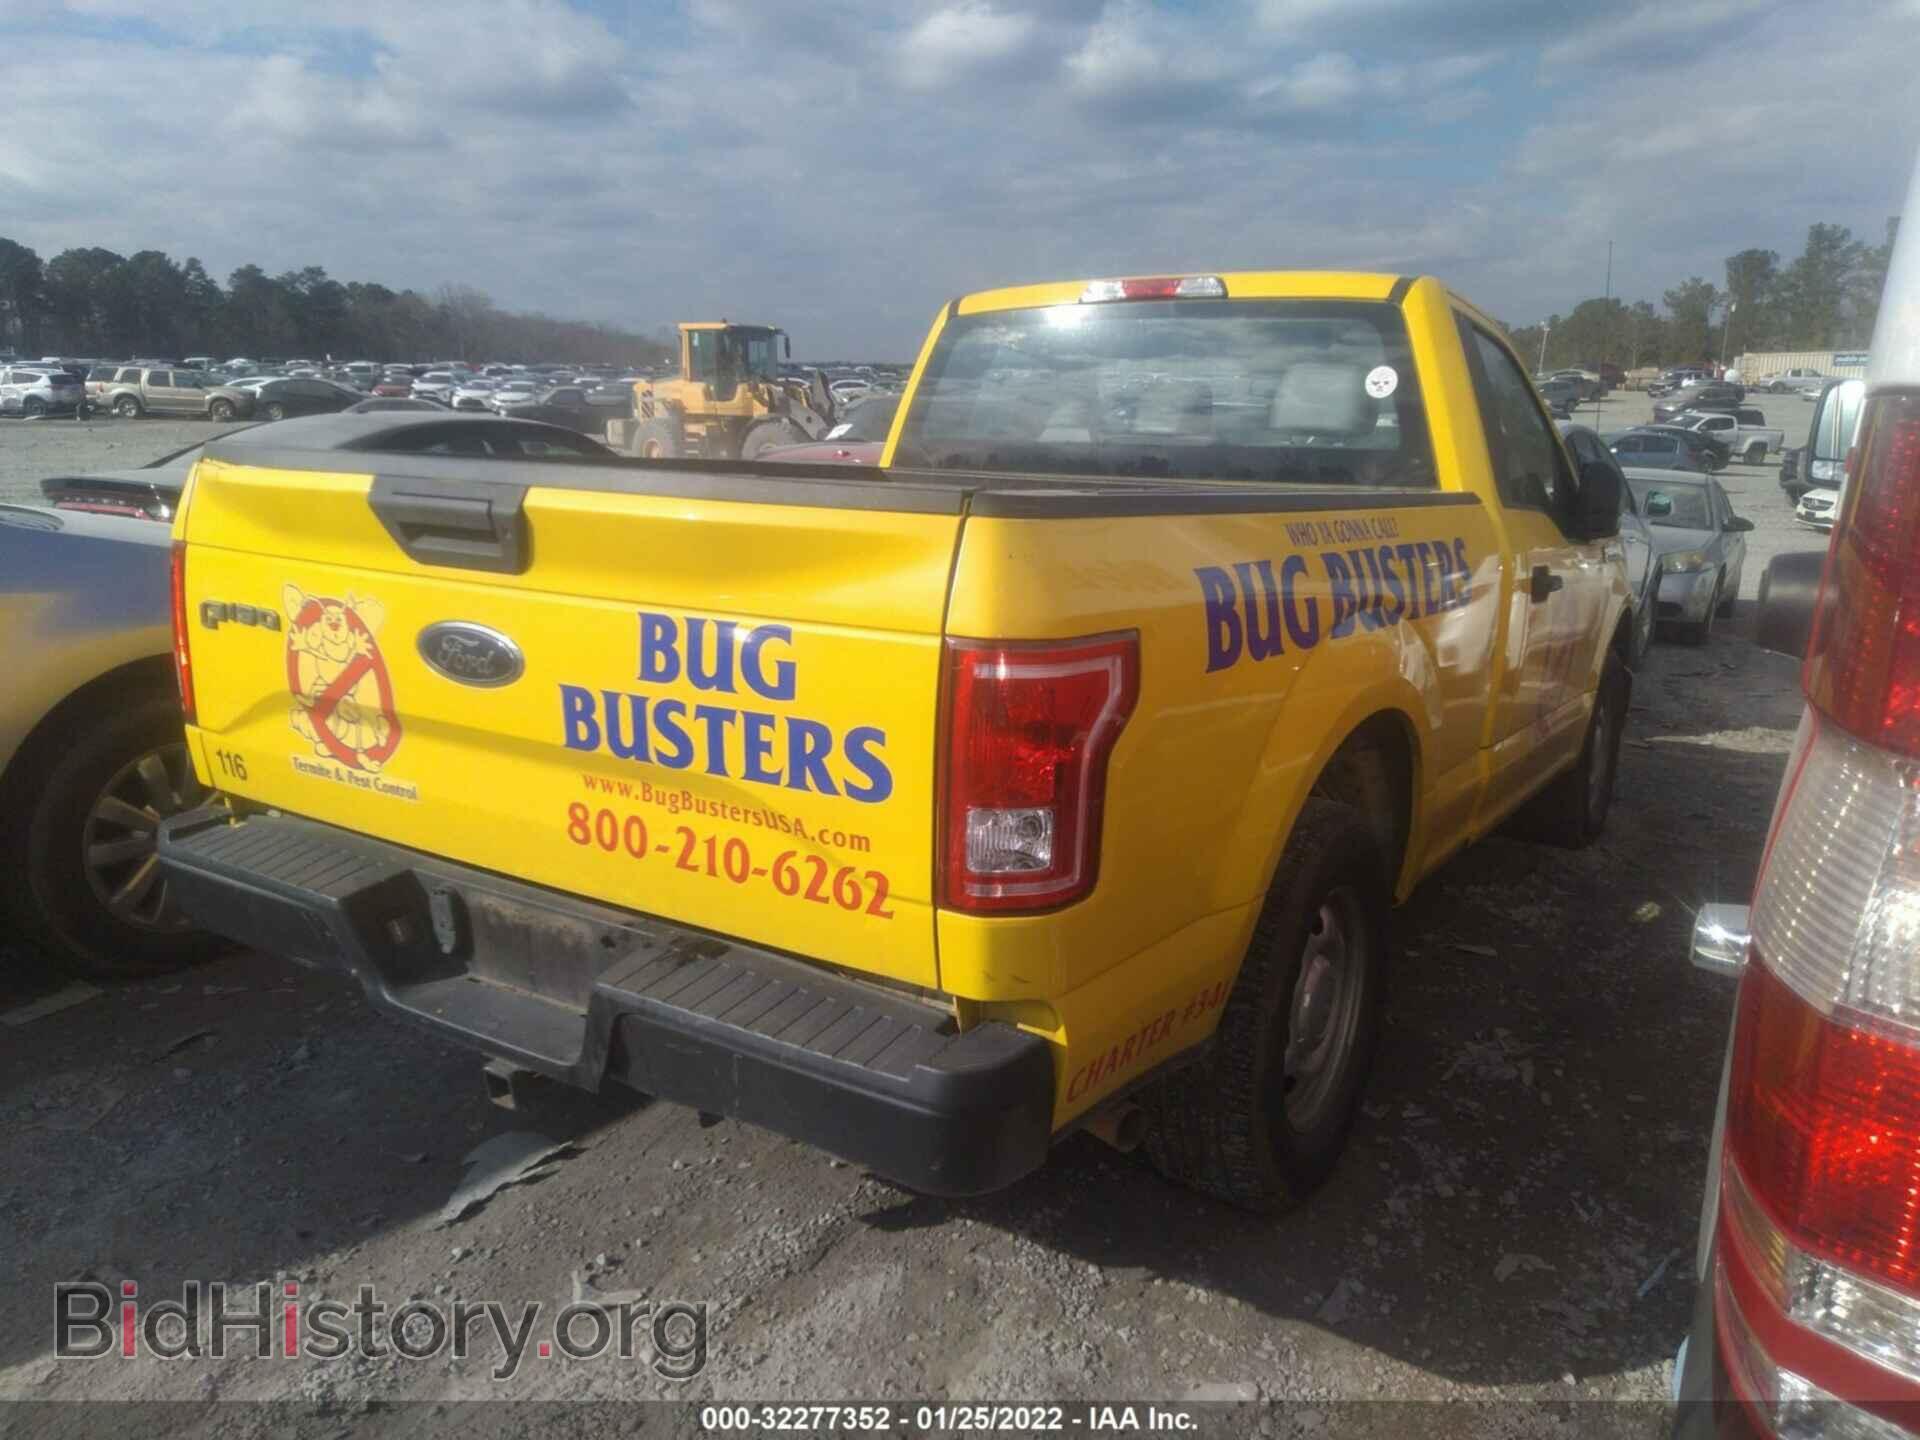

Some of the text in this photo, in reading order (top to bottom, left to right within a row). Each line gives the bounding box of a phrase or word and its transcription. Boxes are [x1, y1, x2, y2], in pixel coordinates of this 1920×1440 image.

[1194, 538, 1473, 674] BUG BUSTERS
[637, 611, 797, 701] BUG
[216, 749, 248, 781] 116
[292, 756, 418, 800] Termite & Pest Control
[559, 683, 894, 804] BUSTERS
[582, 773, 872, 853] www.BugBustersUSA.com
[566, 801, 895, 921] 800-210-6262
[1066, 1008, 1177, 1105] CHARTER
